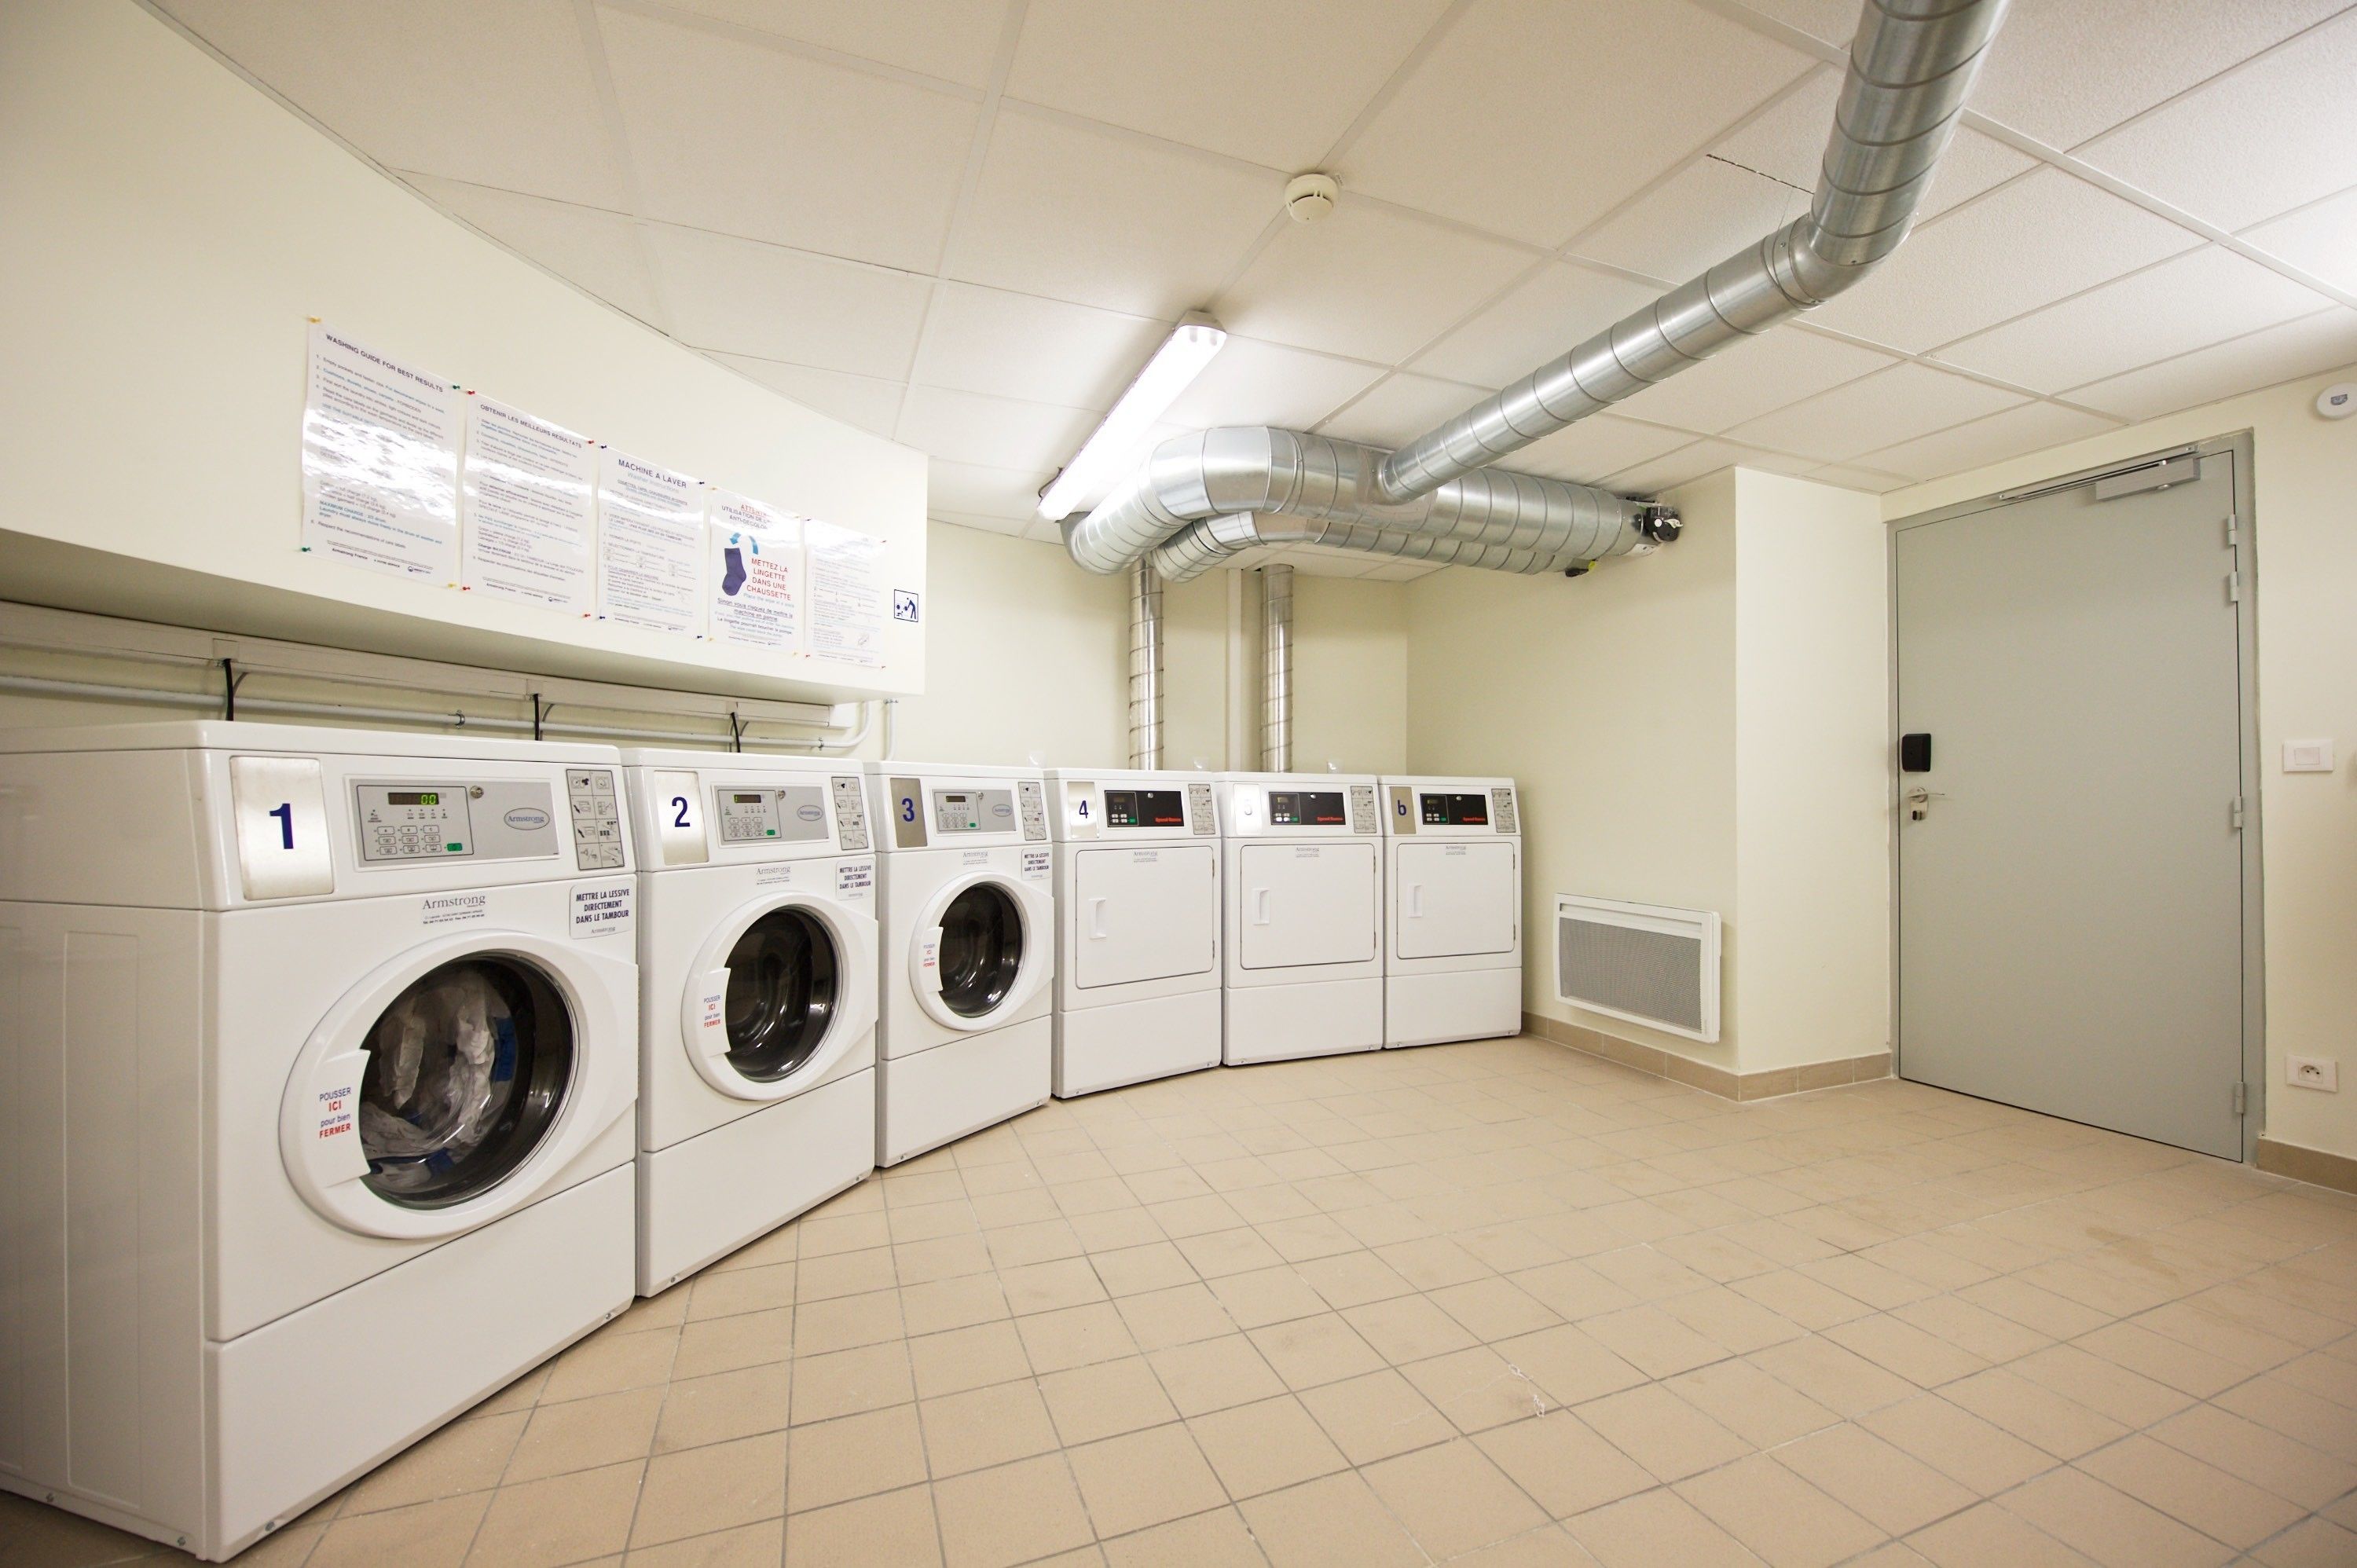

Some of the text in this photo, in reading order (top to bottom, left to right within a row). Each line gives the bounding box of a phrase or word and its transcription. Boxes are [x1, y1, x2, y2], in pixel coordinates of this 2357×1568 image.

[326, 333, 442, 393] WASHING GUIDE FOR BEST RESULTS
[480, 403, 581, 449] OBTENIR LES MEILLEURS RESULTATS
[618, 459, 653, 477] MACHINE
[662, 474, 686, 489] LAVER
[721, 504, 754, 519] UTILISATION
[751, 557, 778, 570] METTEZ
[753, 567, 785, 581] LINGETTE
[752, 576, 786, 591] DANS UNE
[746, 584, 790, 601] CHAUSSETTE
[421, 795, 436, 804] 00
[672, 797, 691, 827] 2
[902, 798, 915, 822] 3
[1080, 800, 1088, 819] 4
[269, 803, 293, 849] 1
[757, 866, 790, 875] Armstrong
[423, 896, 486, 910] Armstrong
[576, 892, 598, 901] METTRE
[585, 900, 622, 911] DIRECTEMENT
[576, 915, 592, 924] DANS
[603, 910, 629, 920] TAMBOUR
[704, 1019, 720, 1028] FERMER
[319, 1087, 351, 1101] POUSSER
[328, 1101, 342, 1112] ICI
[321, 1114, 350, 1128] pour bien
[319, 1123, 351, 1138] FERMER
